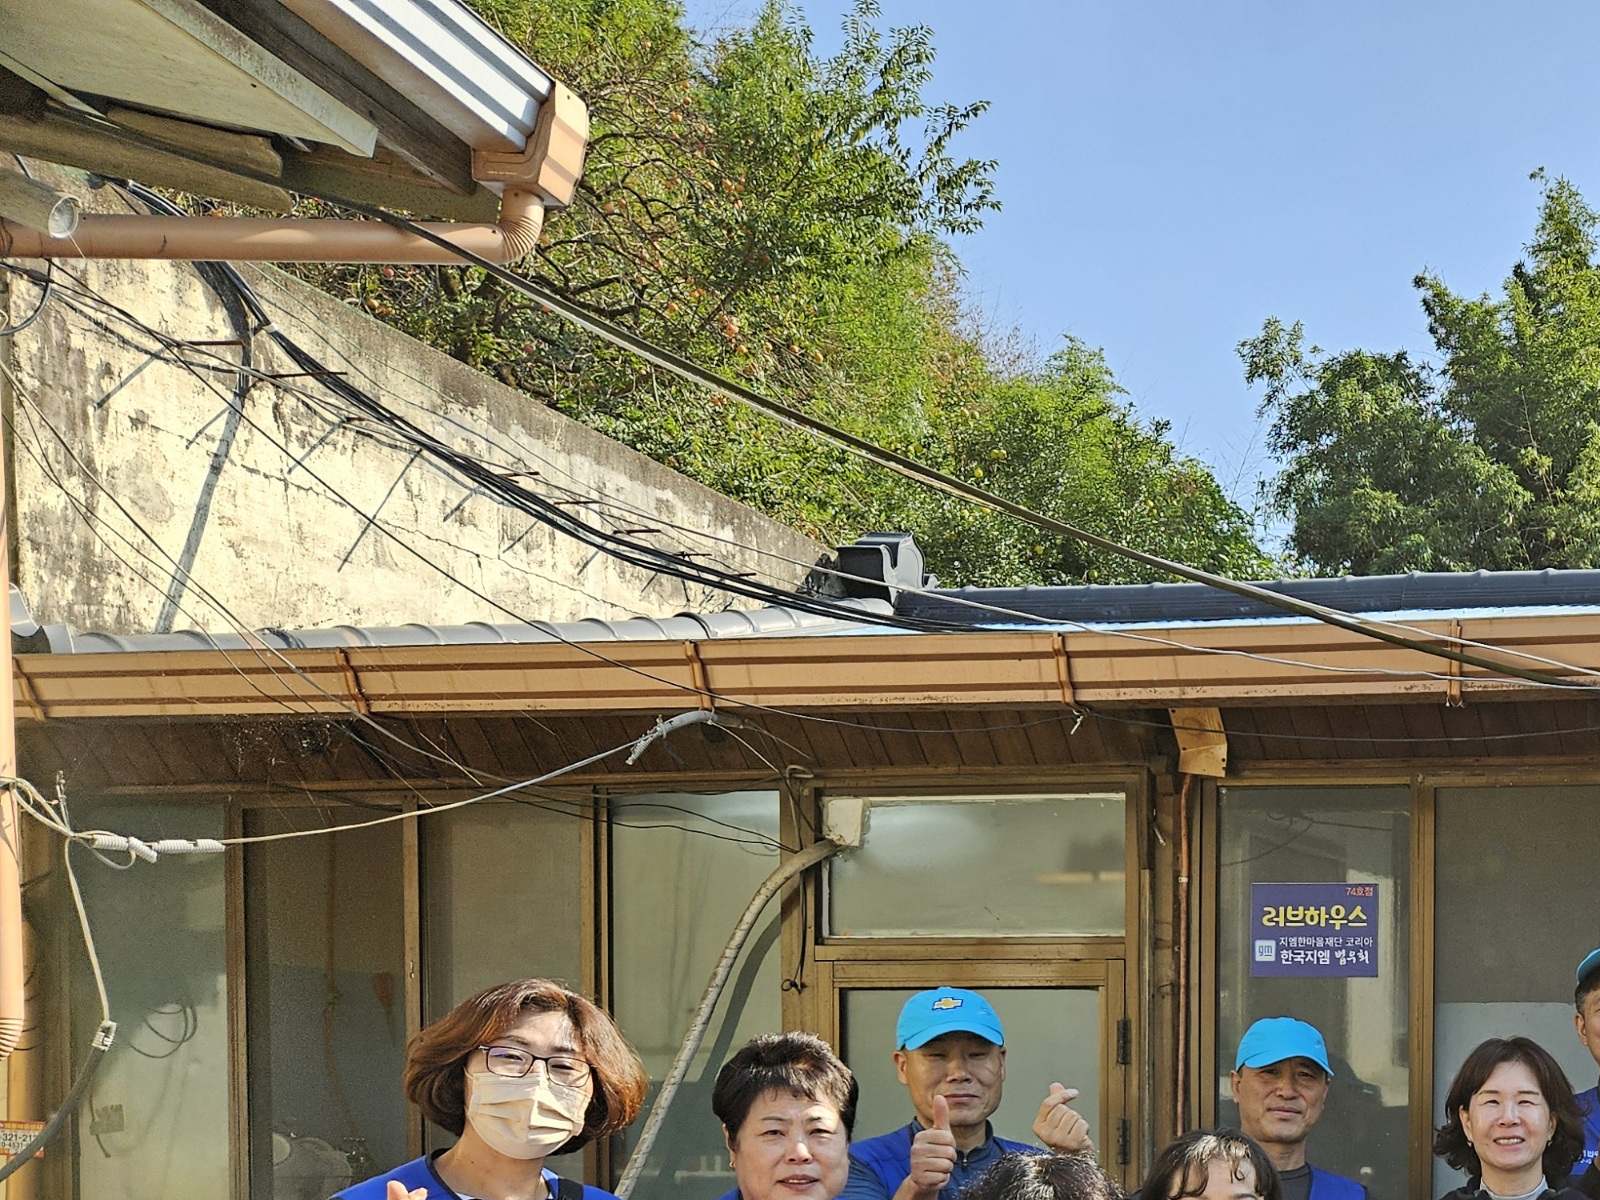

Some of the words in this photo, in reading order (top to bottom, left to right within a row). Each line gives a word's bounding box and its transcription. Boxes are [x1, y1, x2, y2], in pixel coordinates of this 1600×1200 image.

[1345, 886, 1374, 897] 74호점
[1262, 904, 1368, 930] 러브하우스
[1279, 937, 1343, 948] 지엠한마음재단
[1345, 937, 1374, 948] 코리아
[1280, 949, 1330, 965] 한국지엠
[1334, 949, 1370, 966] 법우회
